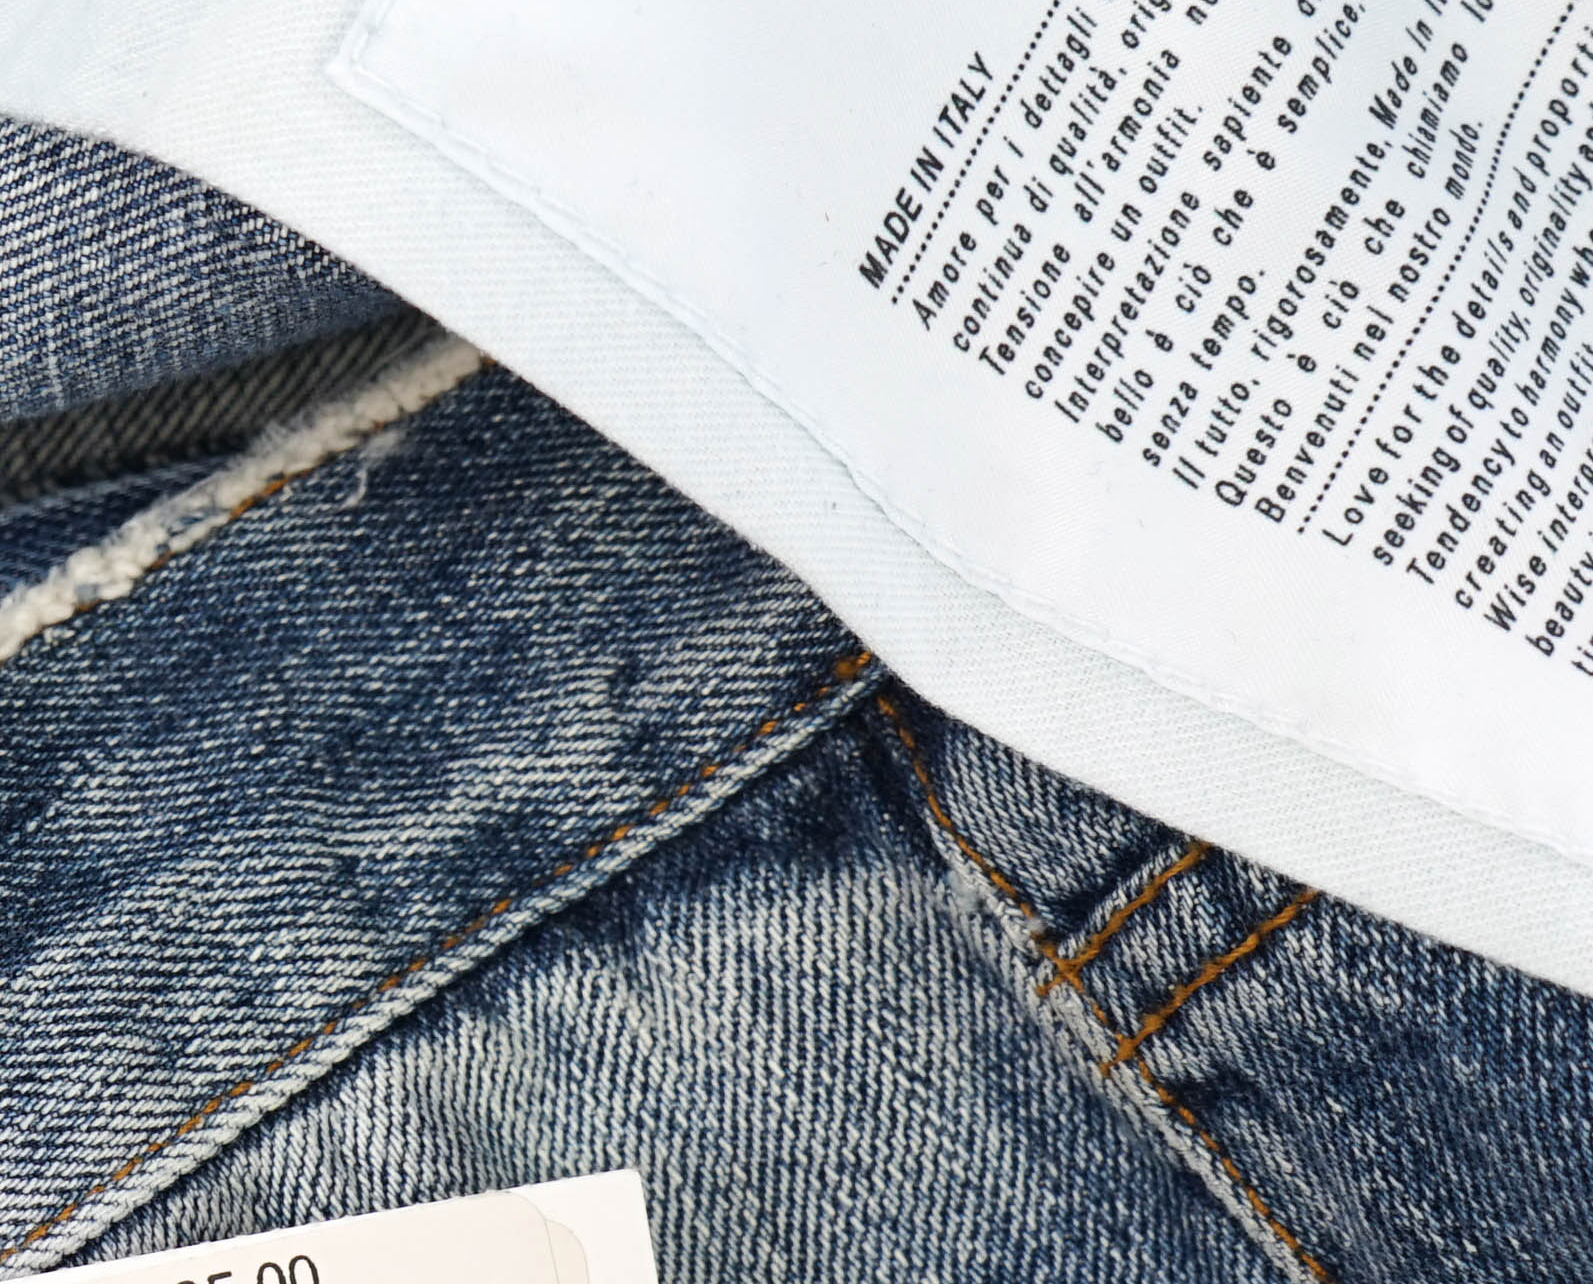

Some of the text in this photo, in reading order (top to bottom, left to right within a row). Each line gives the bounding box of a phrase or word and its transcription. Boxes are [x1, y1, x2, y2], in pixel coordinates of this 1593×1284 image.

[857, 49, 994, 290] MADE IN ITALY
[910, 230, 978, 332] Amore
[974, 163, 1010, 227] per
[1001, 134, 1024, 159] i
[1018, 5, 1098, 130] dettagli
[951, 222, 1033, 353] continua
[1021, 174, 1054, 214] di
[1047, 65, 1128, 176] qualità,
[977, 241, 1071, 376] Tensione
[1072, 48, 1181, 224] all'armonia
[1023, 105, 1203, 400] concepire un outfit.
[1052, 190, 1200, 424] Interpretazione
[1201, 35, 1293, 172] sapiente
[1094, 368, 1155, 444] bello
[1143, 327, 1174, 353] è
[1174, 261, 1213, 314] ciò
[1211, 187, 1254, 247] che
[1245, 147, 1277, 172] è
[1275, 2, 1366, 135] semplice,
[1170, 454, 1206, 490] Il
[1193, 378, 1261, 458] tutto,
[1249, 139, 1393, 362] rigorosamente,
[1367, 54, 1418, 131] Made
[1404, 18, 1434, 53] In
[1361, 197, 1406, 256] che
[1383, 41, 1469, 180] chiamiamo
[1140, 268, 1265, 468] senza tempo.
[1252, 121, 1483, 524] Benvenuti nel nostro mondo.
[1284, 352, 1318, 374] è
[1320, 278, 1360, 330] ciò
[1320, 465, 1390, 547] Love
[1373, 402, 1423, 460] for
[1411, 343, 1462, 401] the
[1450, 229, 1515, 339] details
[1506, 165, 1537, 231] and
[1371, 160, 1593, 567] seeking of quality, originality
[1404, 227, 1593, 585] Tendency to harmony wh
[1213, 397, 1293, 508] Questo
[1453, 467, 1552, 610] creating
[1537, 430, 1565, 470] an
[1482, 437, 1593, 632] Wise interp
[1570, 634, 1593, 677] ti
